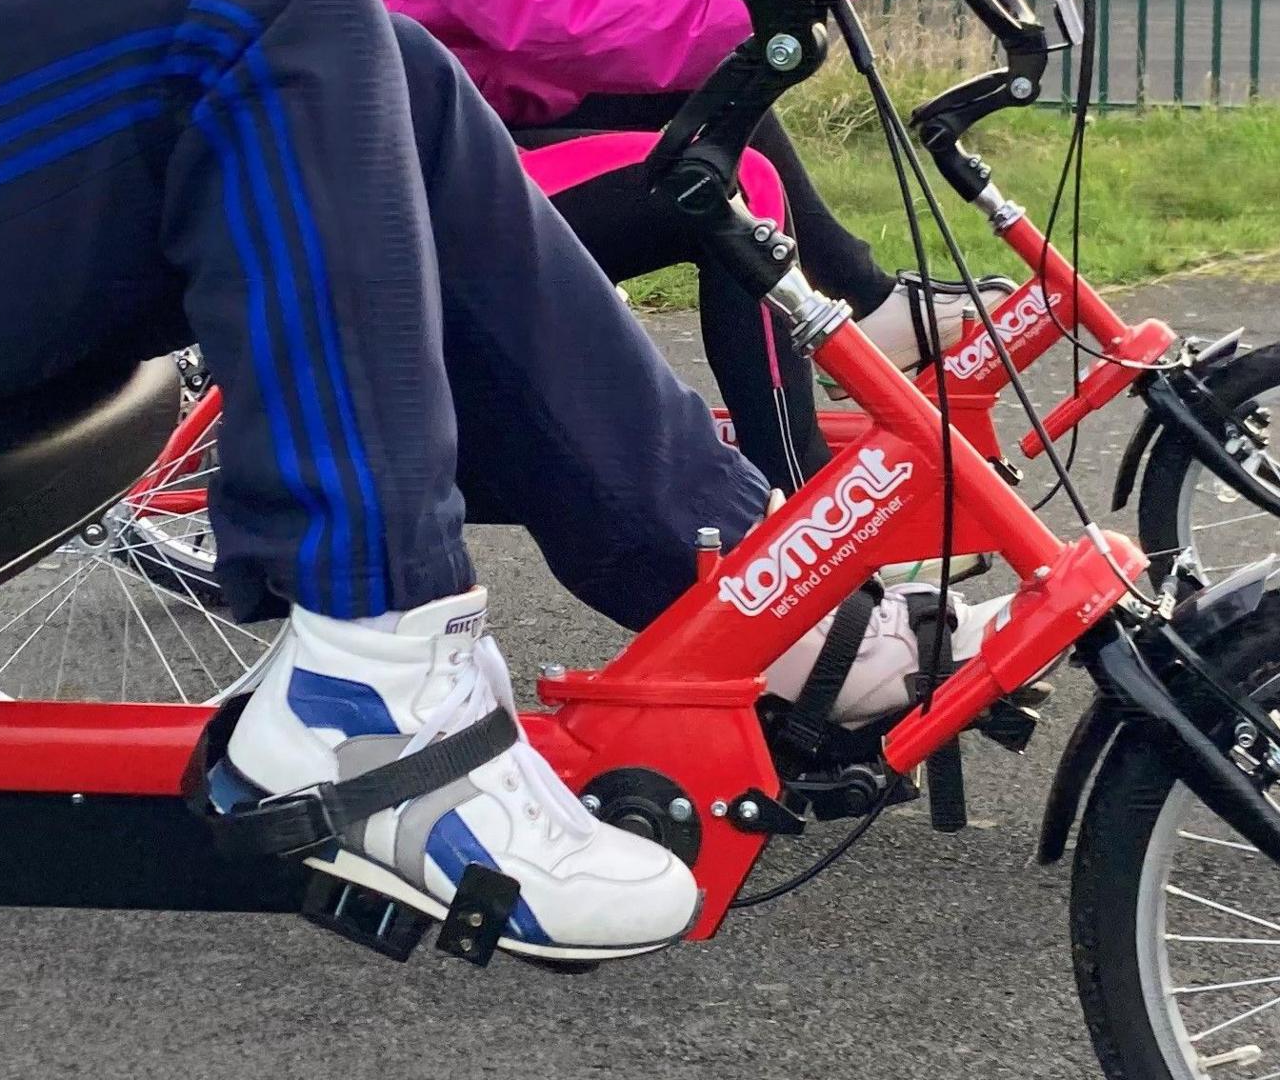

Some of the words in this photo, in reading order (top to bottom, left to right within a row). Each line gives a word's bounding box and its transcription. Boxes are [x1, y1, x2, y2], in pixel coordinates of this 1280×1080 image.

[717, 447, 914, 617] tomcat
[770, 594, 799, 619] let's
[793, 569, 822, 597] find
[819, 564, 832, 576] a
[828, 540, 858, 566] way
